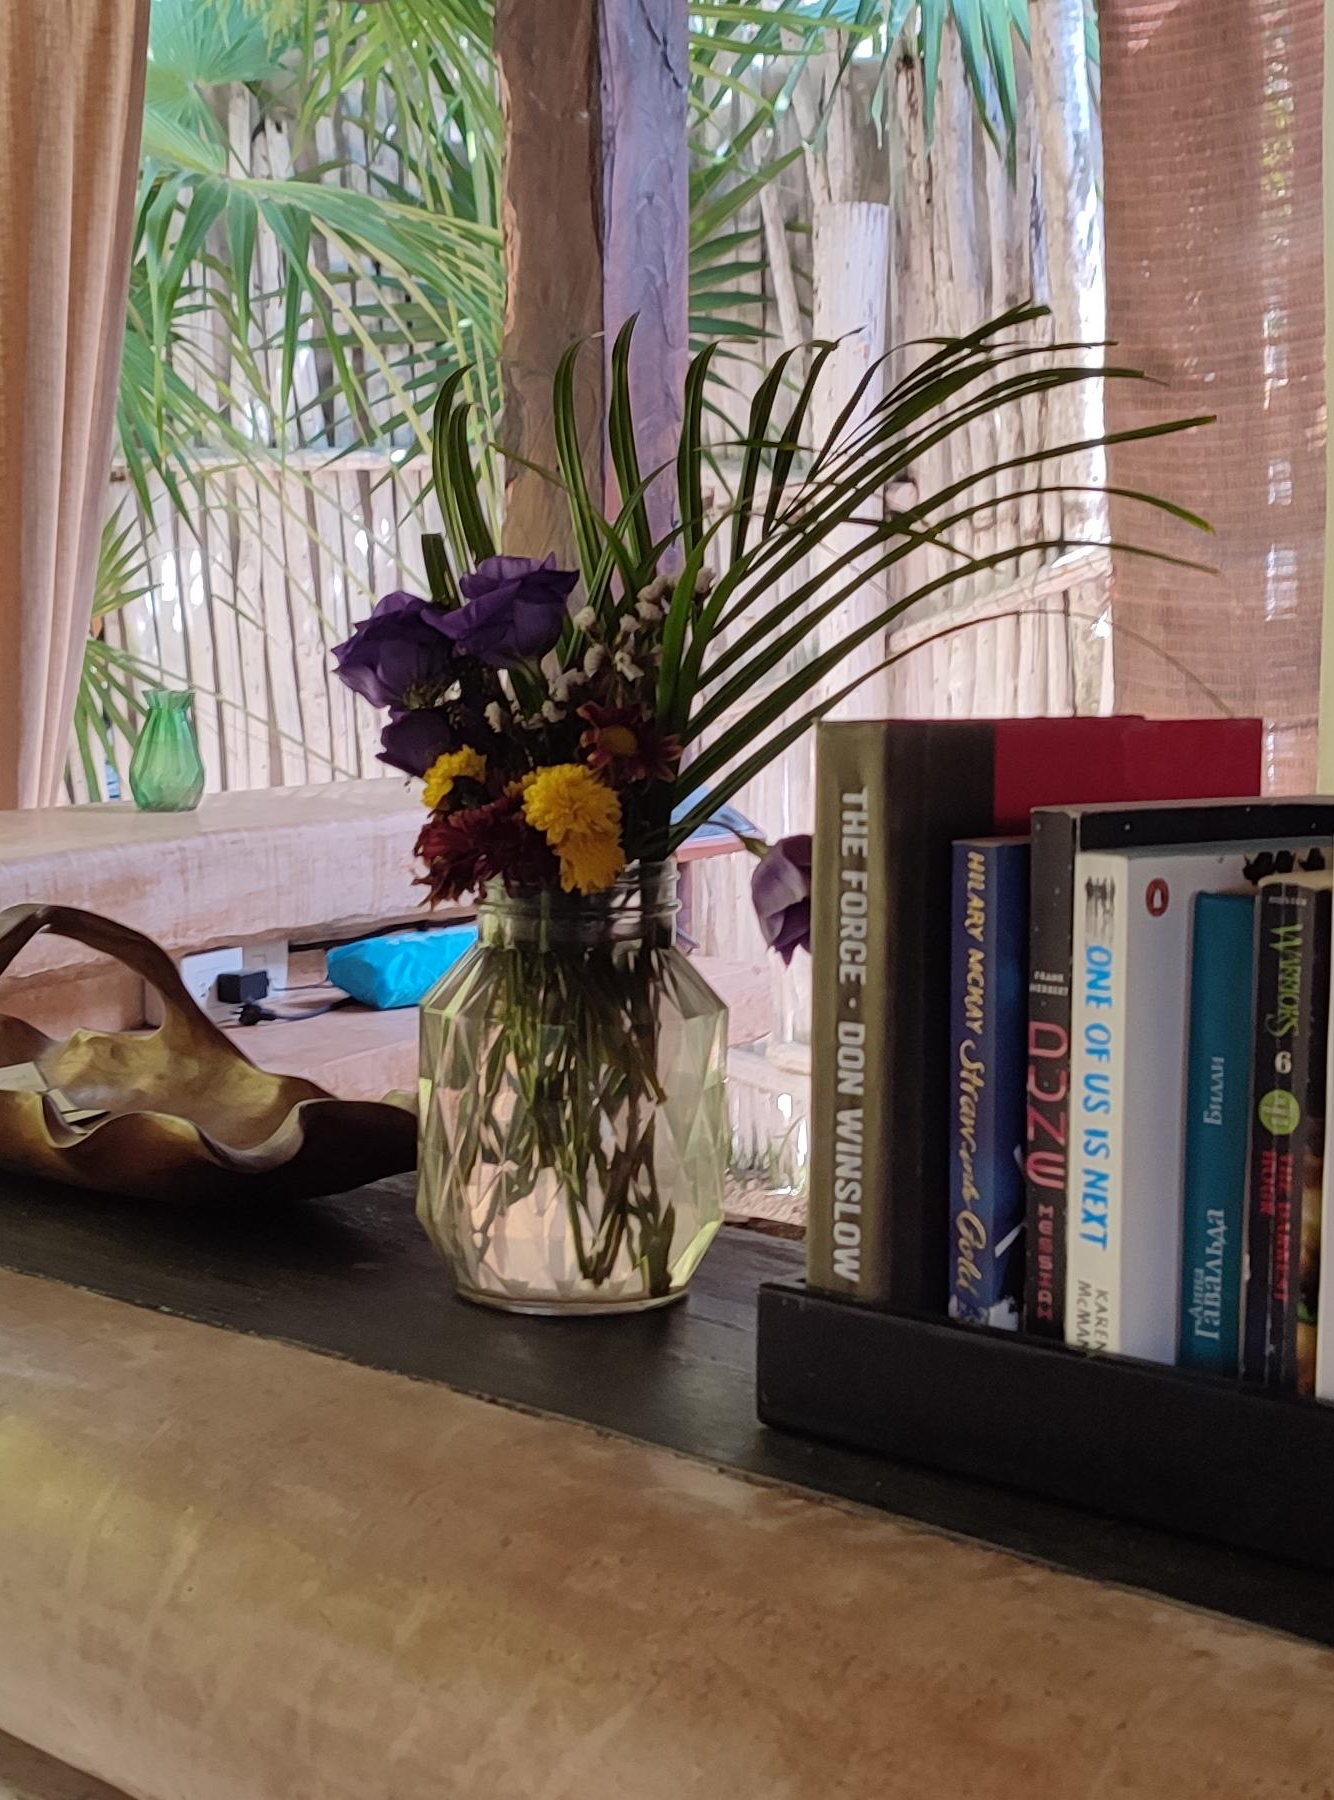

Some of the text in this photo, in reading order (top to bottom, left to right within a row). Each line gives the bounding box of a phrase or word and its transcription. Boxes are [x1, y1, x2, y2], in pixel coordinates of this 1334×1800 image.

[964, 851, 986, 942] HILARY
[833, 787, 868, 1283] THE FORCE DON WINSLOW
[1203, 1056, 1225, 1126] Билли
[1274, 1050, 1293, 1074] 6
[958, 1039, 986, 1154] Straw
[1026, 1020, 1069, 1190] DUNE
[1079, 944, 1113, 1251] ONE OF US IS NEXT
[955, 1207, 987, 1298] Gold
[1194, 1208, 1228, 1340] Гавальда
